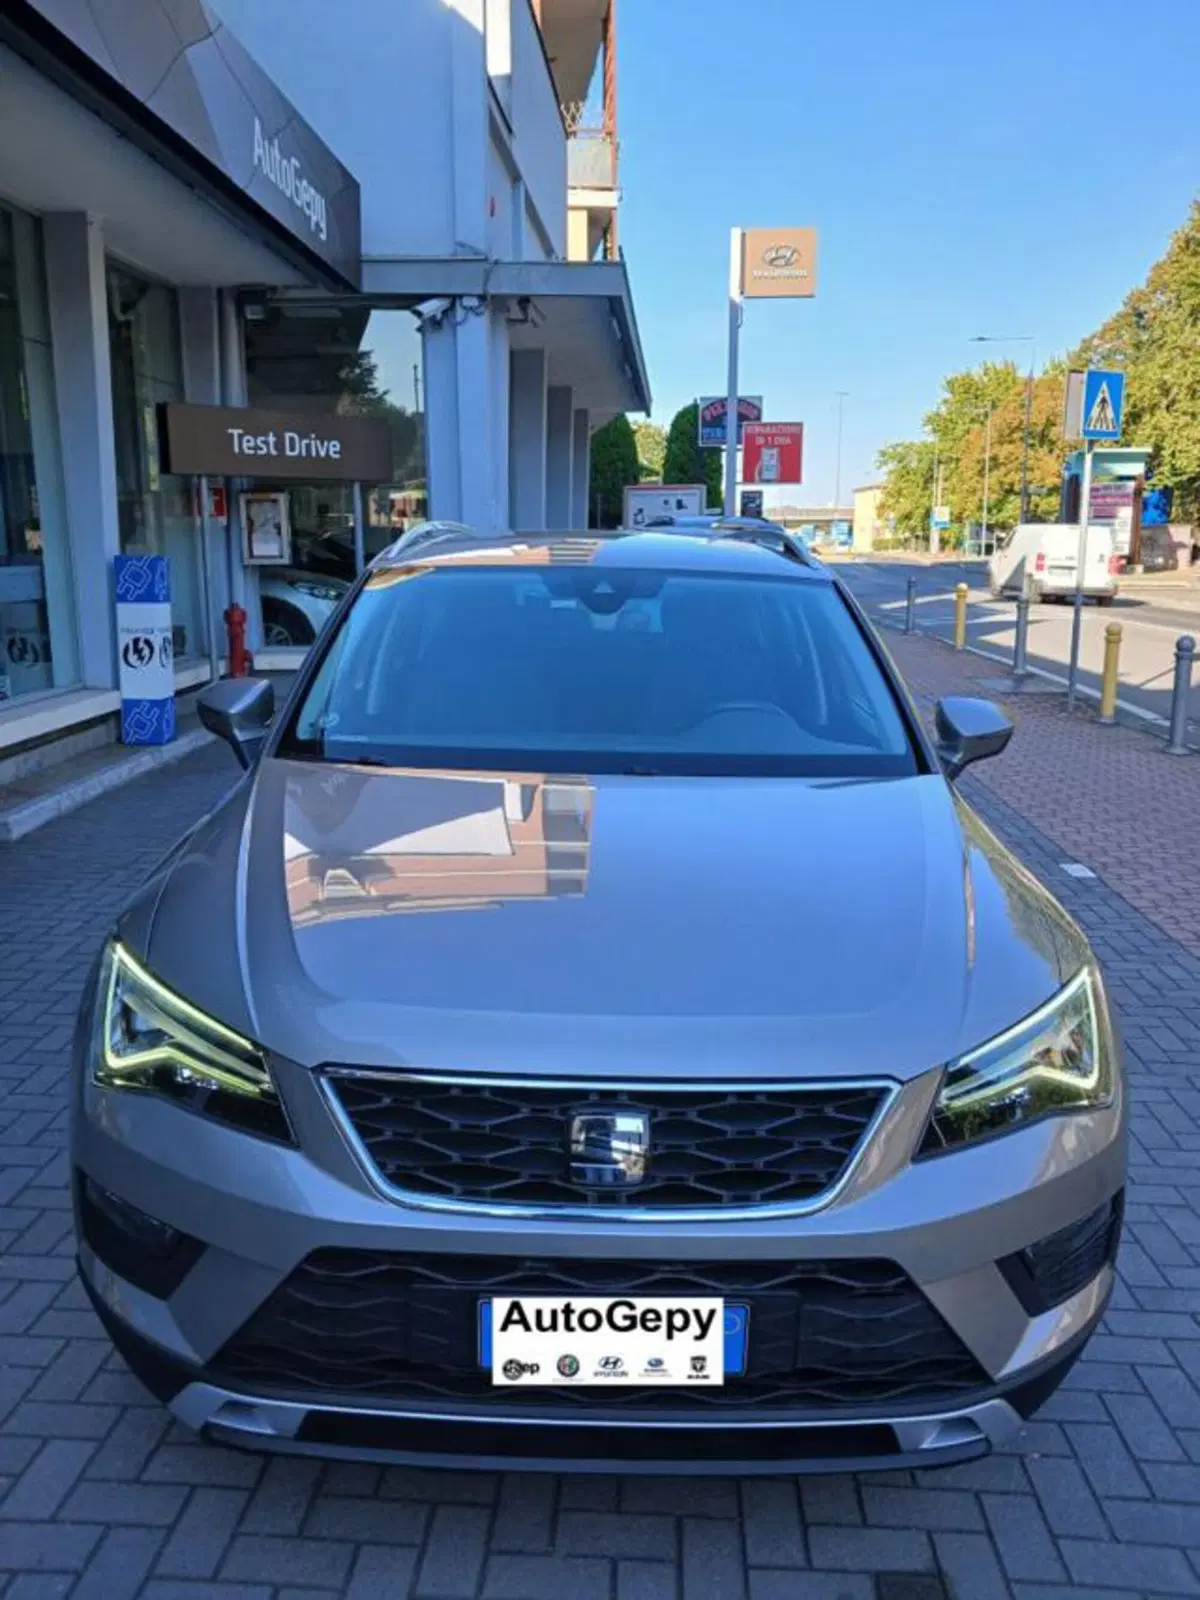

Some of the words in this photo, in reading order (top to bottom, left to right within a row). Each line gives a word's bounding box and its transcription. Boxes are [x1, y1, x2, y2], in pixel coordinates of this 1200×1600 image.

[254, 116, 327, 241] AutoGepy
[226, 427, 278, 456] Test
[284, 431, 341, 459] Drive
